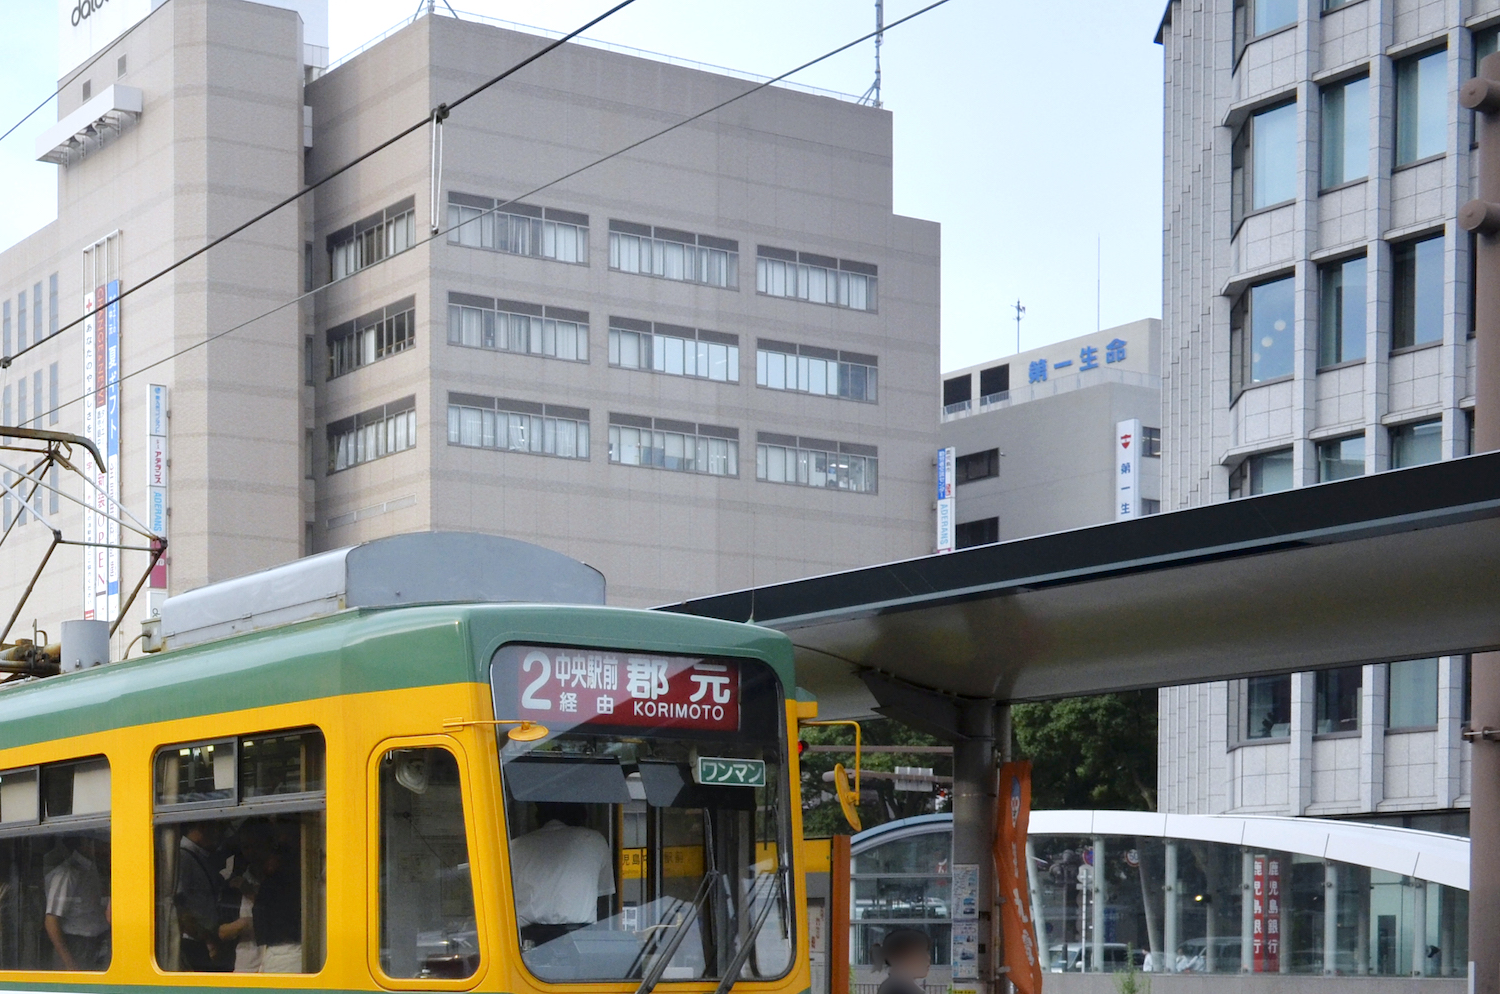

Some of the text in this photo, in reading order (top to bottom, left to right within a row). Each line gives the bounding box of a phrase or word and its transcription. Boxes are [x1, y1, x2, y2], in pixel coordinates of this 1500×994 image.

[1028, 338, 1127, 384] 第一生命
[108, 345, 117, 440] 夏ギフト
[153, 491, 162, 532] ADERANS
[940, 504, 949, 546] ADERANS
[521, 651, 552, 710] 2
[555, 652, 618, 691] 中央駅前
[559, 691, 725, 721] 経由 KORIMOTO
[701, 762, 763, 784] ワンマン
[1268, 861, 1279, 954] 鹿児島銀行
